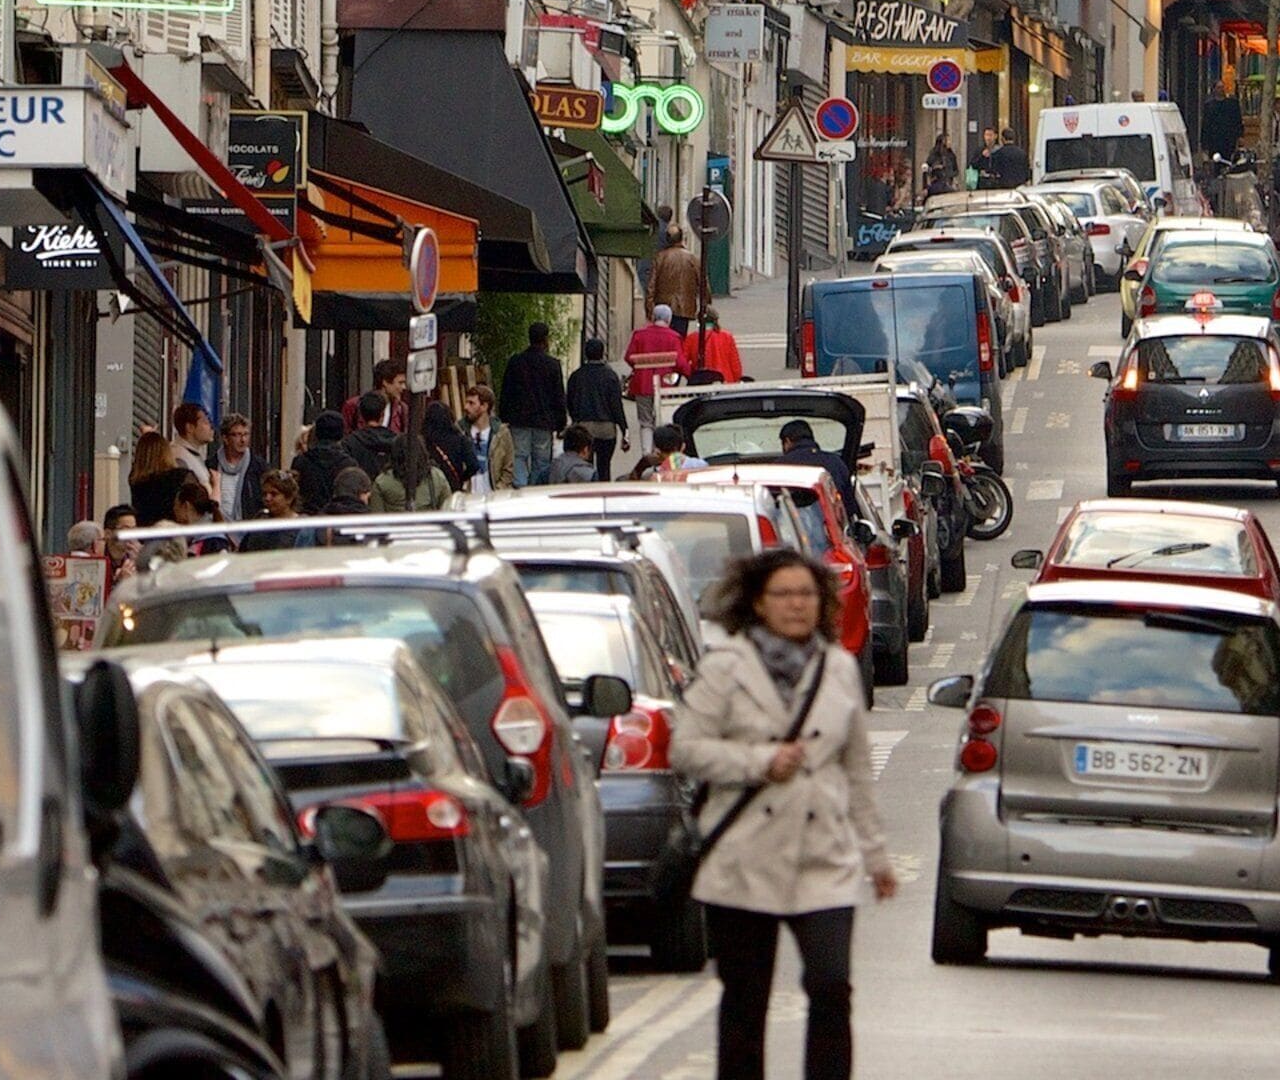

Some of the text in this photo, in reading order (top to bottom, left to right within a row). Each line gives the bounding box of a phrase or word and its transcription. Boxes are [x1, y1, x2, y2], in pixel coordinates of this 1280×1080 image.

[727, 7, 760, 17] make
[854, 0, 959, 44] RESTAURANT
[708, 48, 740, 58] mark
[851, 51, 936, 67] BAR COCKTA
[1092, 750, 1201, 775] BB-562-ZN
